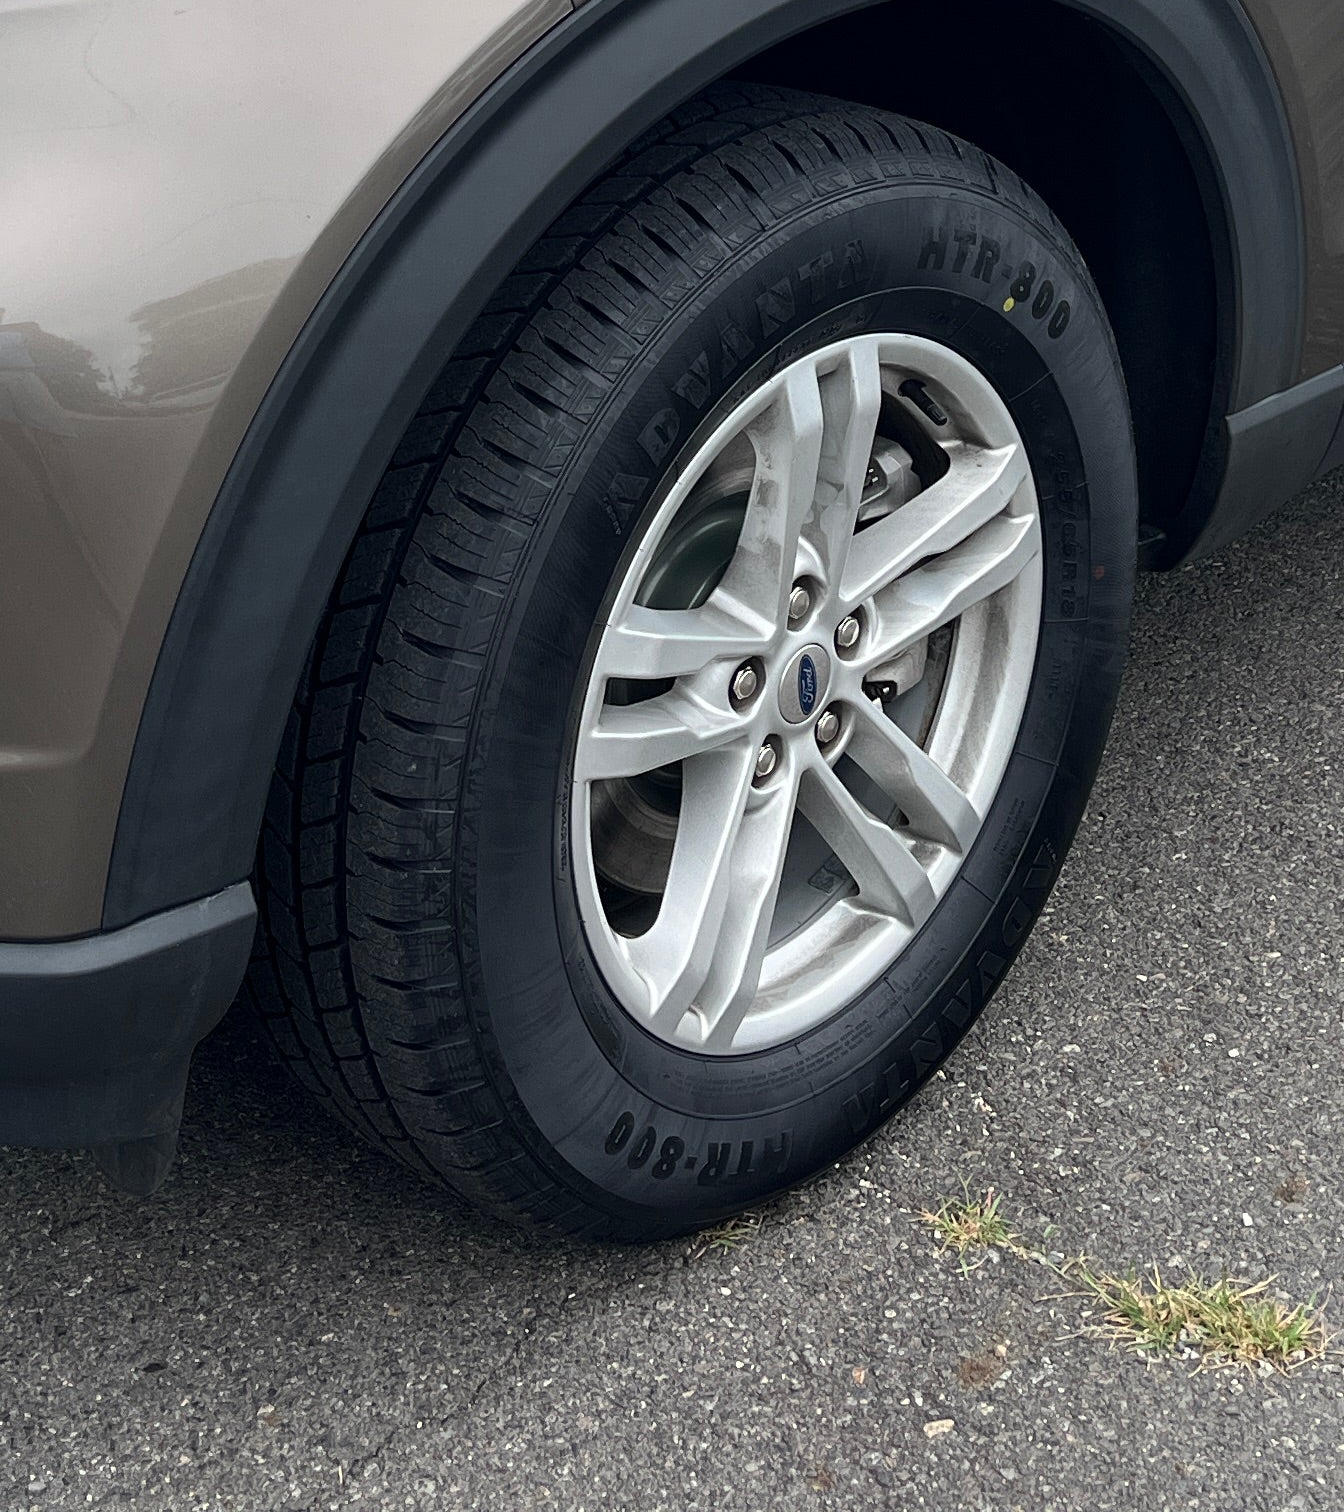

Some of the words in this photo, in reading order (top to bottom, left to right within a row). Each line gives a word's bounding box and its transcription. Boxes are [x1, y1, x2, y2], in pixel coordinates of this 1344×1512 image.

[915, 223, 1072, 341] HTR-800
[607, 238, 869, 521] ADVANTA
[604, 1108, 793, 1186] HTR-800
